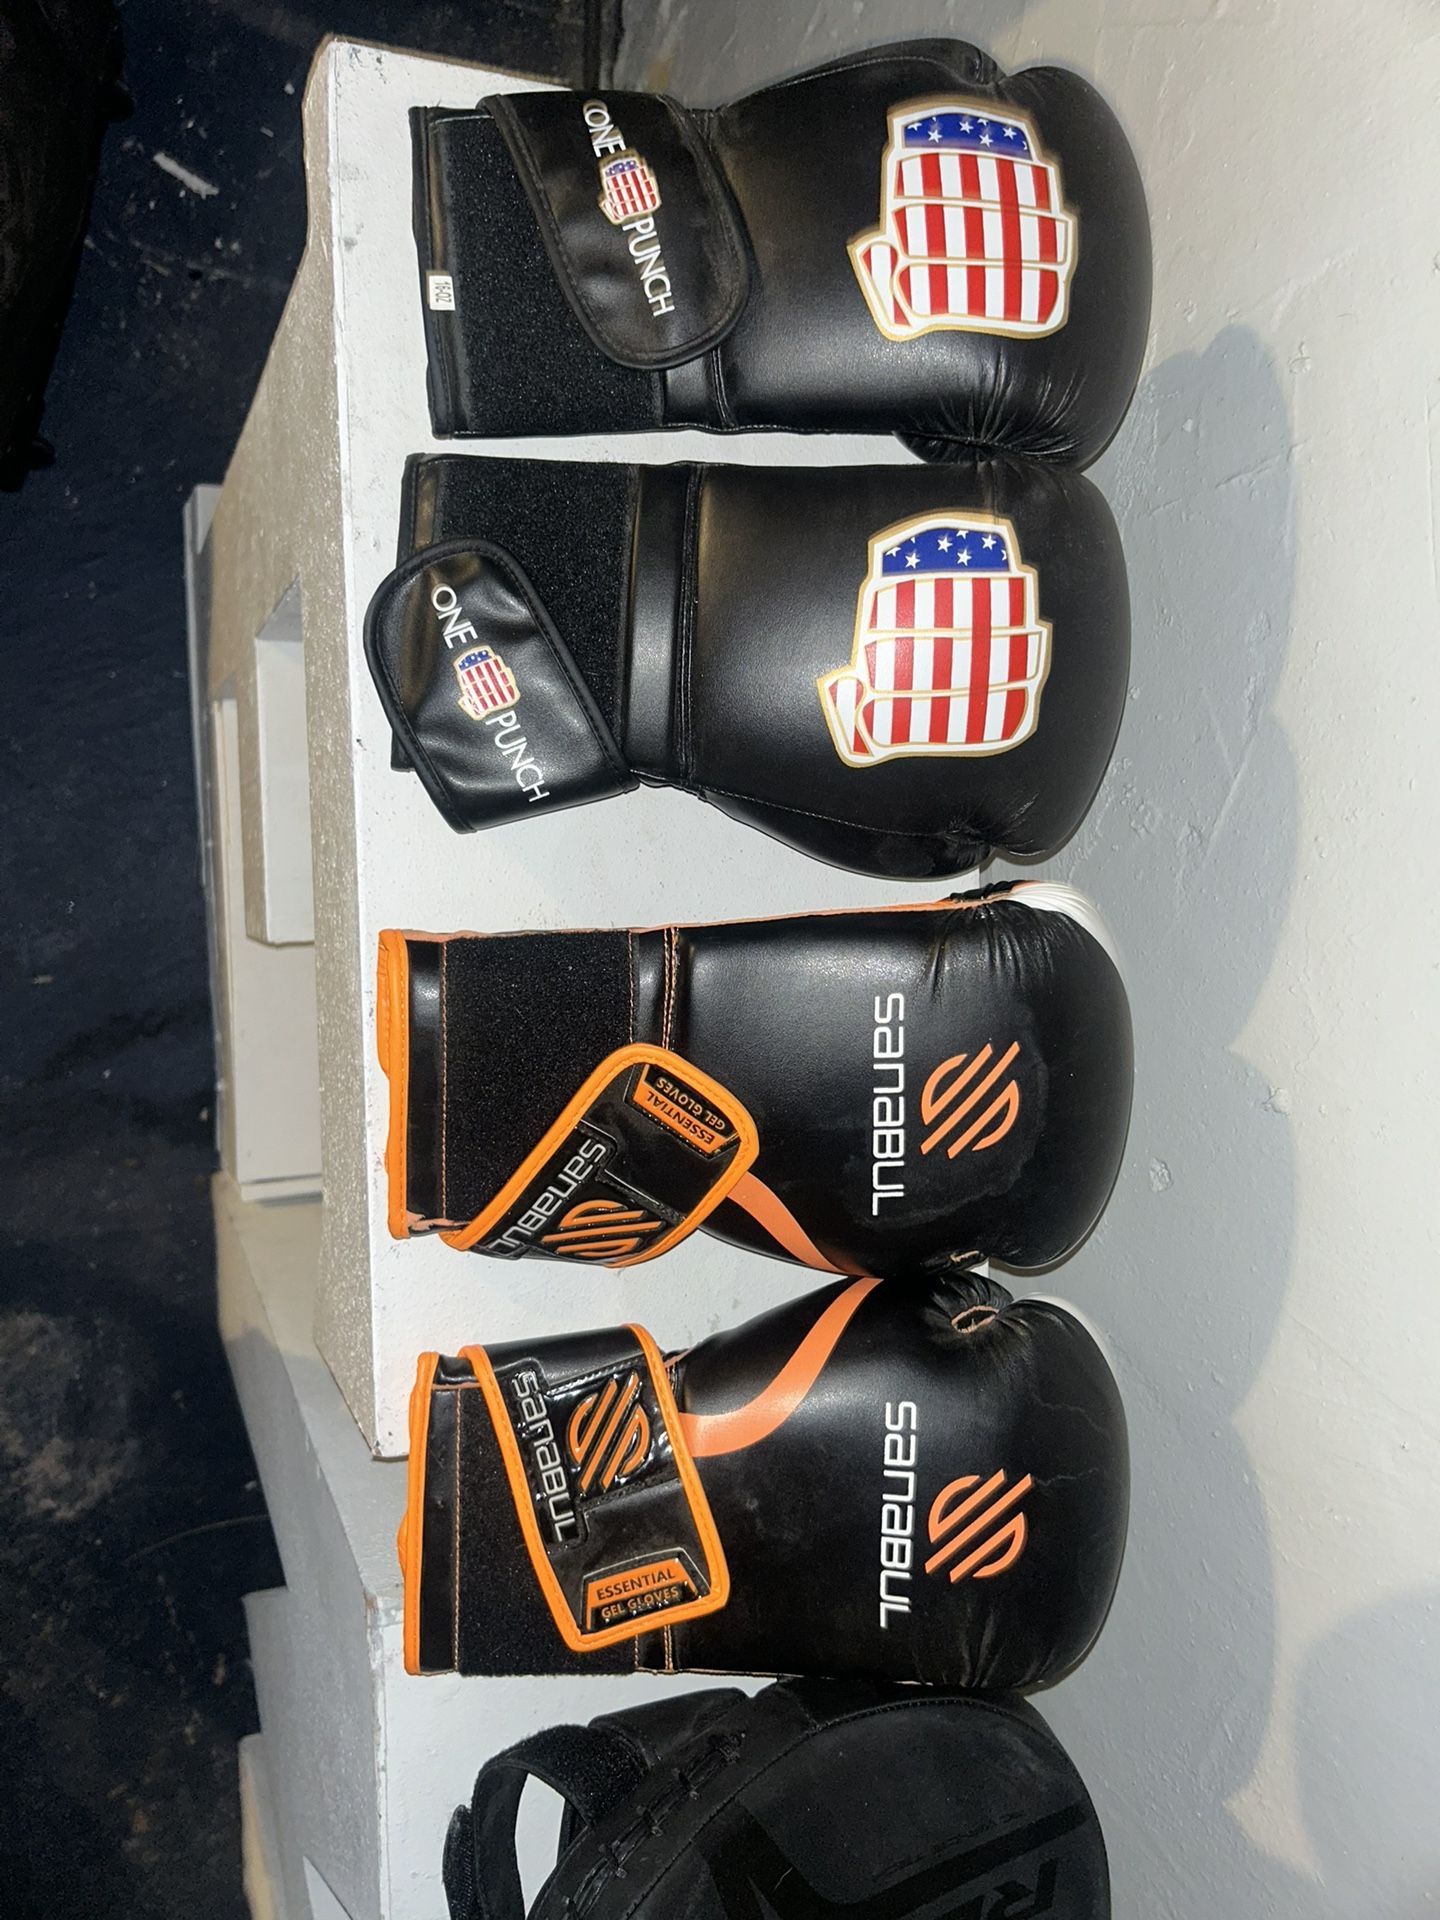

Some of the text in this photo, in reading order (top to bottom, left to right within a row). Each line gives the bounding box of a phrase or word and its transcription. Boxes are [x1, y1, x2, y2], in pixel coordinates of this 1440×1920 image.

[584, 107, 676, 317] ONE PUNCH
[431, 584, 550, 803] ONE PUNCH
[647, 1090, 716, 1145] ESSENTIAL
[655, 1077, 726, 1130] GEL GLOVES
[596, 1568, 676, 1601] ESSENTIAL
[601, 1586, 679, 1618] GEL GLOVES
